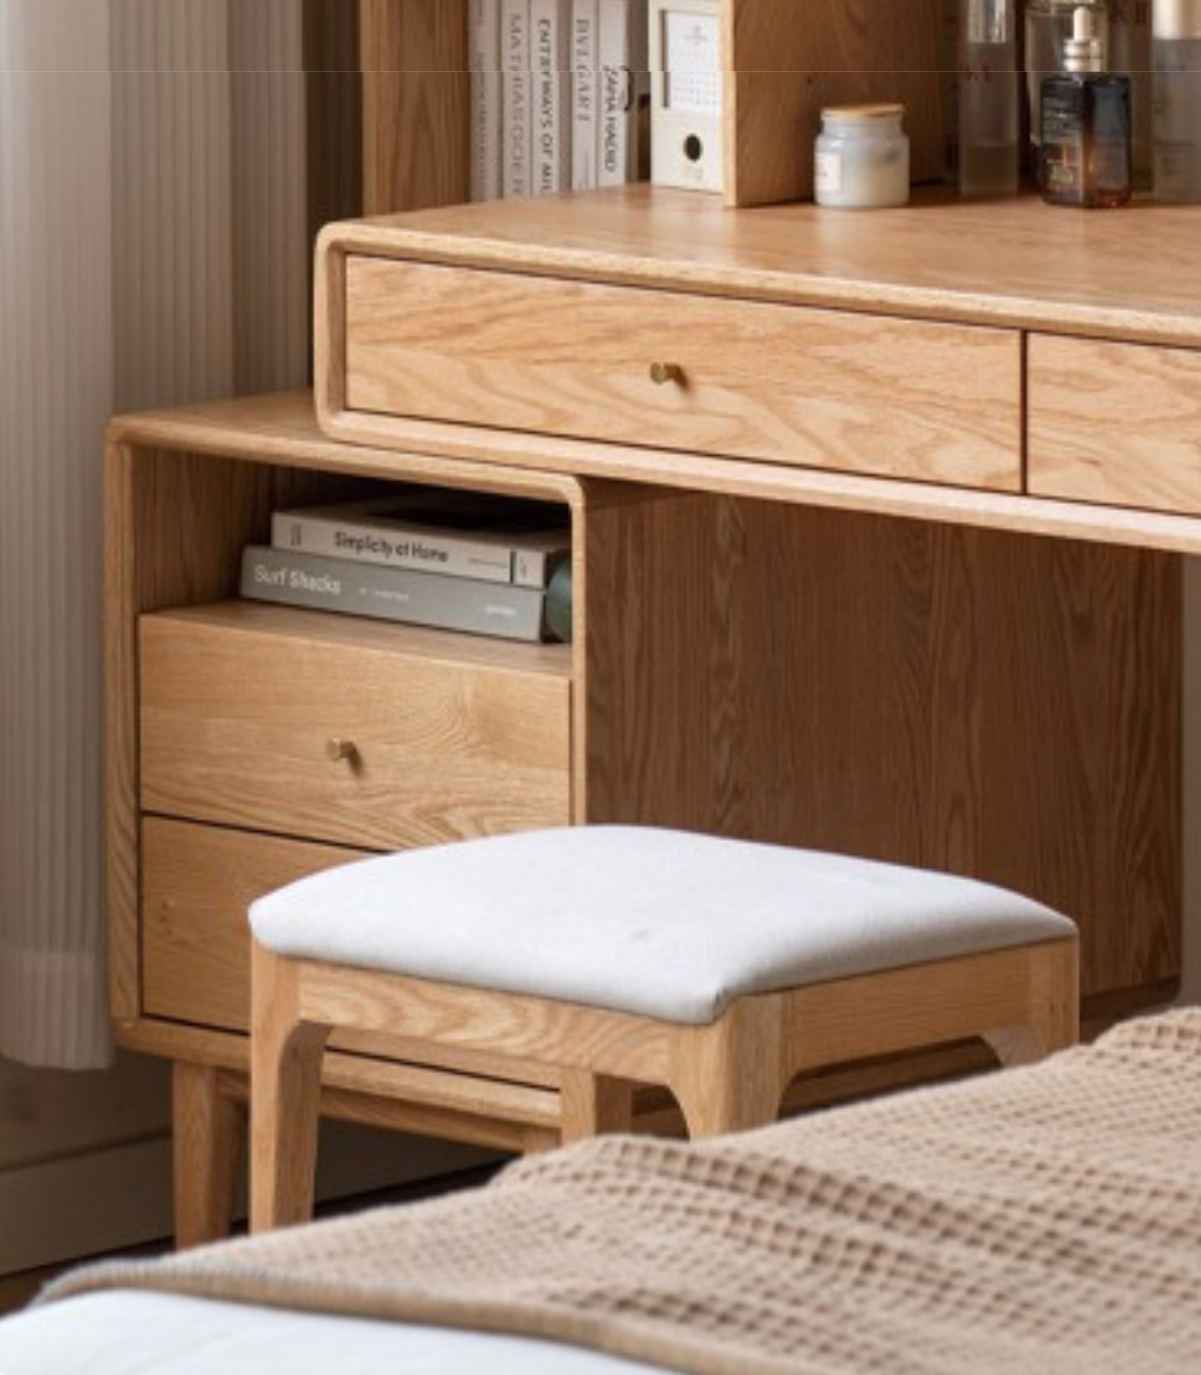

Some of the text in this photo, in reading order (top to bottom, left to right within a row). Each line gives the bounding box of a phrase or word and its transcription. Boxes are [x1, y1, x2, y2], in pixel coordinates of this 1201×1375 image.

[334, 530, 393, 557] Simplicity
[412, 543, 449, 563] Home
[254, 564, 342, 594] Surf Shacks
